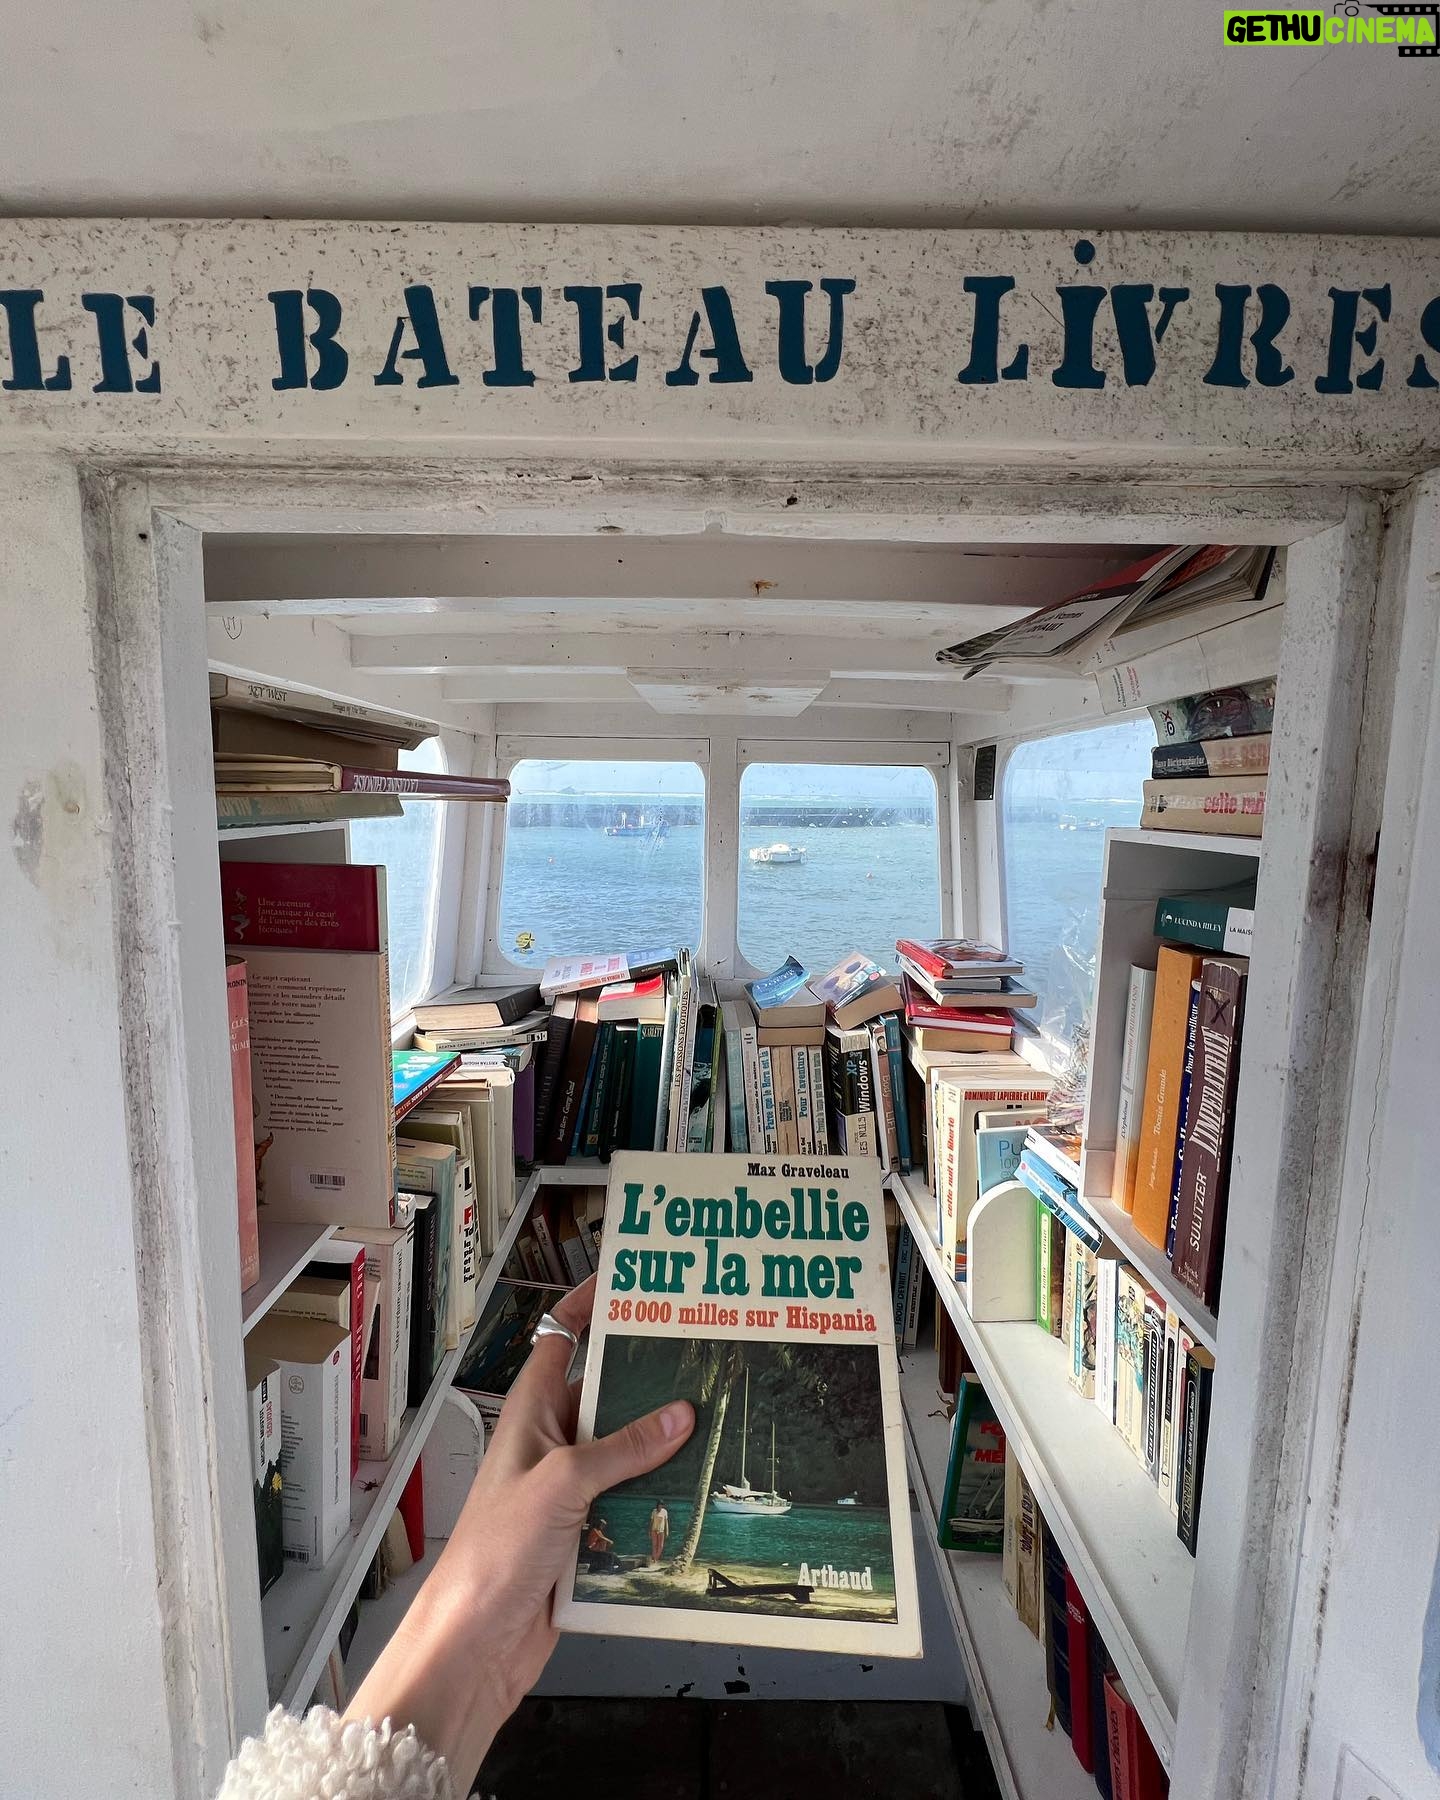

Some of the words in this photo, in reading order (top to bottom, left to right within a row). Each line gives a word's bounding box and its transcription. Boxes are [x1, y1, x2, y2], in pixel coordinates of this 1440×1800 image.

[0, 289, 161, 393] LE
[268, 278, 856, 390] BATEAU
[248, 684, 266, 699] KEY
[266, 688, 288, 702] WEST
[1202, 921, 1223, 933] RILEY
[227, 979, 246, 988] RONIN
[679, 991, 689, 1034] EXOTIQUES
[1127, 984, 1139, 1037] FRIEDMANN
[1188, 1003, 1199, 1042] meilleur
[676, 1037, 685, 1072] POISSONS
[847, 1060, 858, 1075] XP
[796, 1051, 806, 1096] l'aventure
[857, 1060, 869, 1113] Windows
[798, 1097, 808, 1118] Pour
[964, 1090, 996, 1102] DOMINIQUE
[997, 1090, 1023, 1101] LAPIERRE
[1023, 1091, 1030, 1101] et
[1030, 1090, 1048, 1101] LARRY
[1188, 1025, 1230, 1160] L'IMPERATRICE
[766, 1111, 775, 1130] Parce
[858, 1117, 868, 1137] NULS
[858, 1141, 869, 1155] LES
[747, 1162, 776, 1178] Max
[781, 1163, 850, 1180] Graveleau
[618, 1183, 871, 1242] L'embellie
[946, 1189, 954, 1218] cette
[1191, 1169, 1207, 1252] SULITZER
[611, 1247, 696, 1294] sur
[702, 1238, 750, 1296] la
[761, 1253, 863, 1300] mer
[608, 1299, 632, 1322] 36
[634, 1300, 672, 1323] 000
[678, 1302, 739, 1327] milles
[745, 1307, 779, 1328] sur
[786, 1306, 878, 1335] Hispania
[797, 1562, 874, 1591] Arthaud
